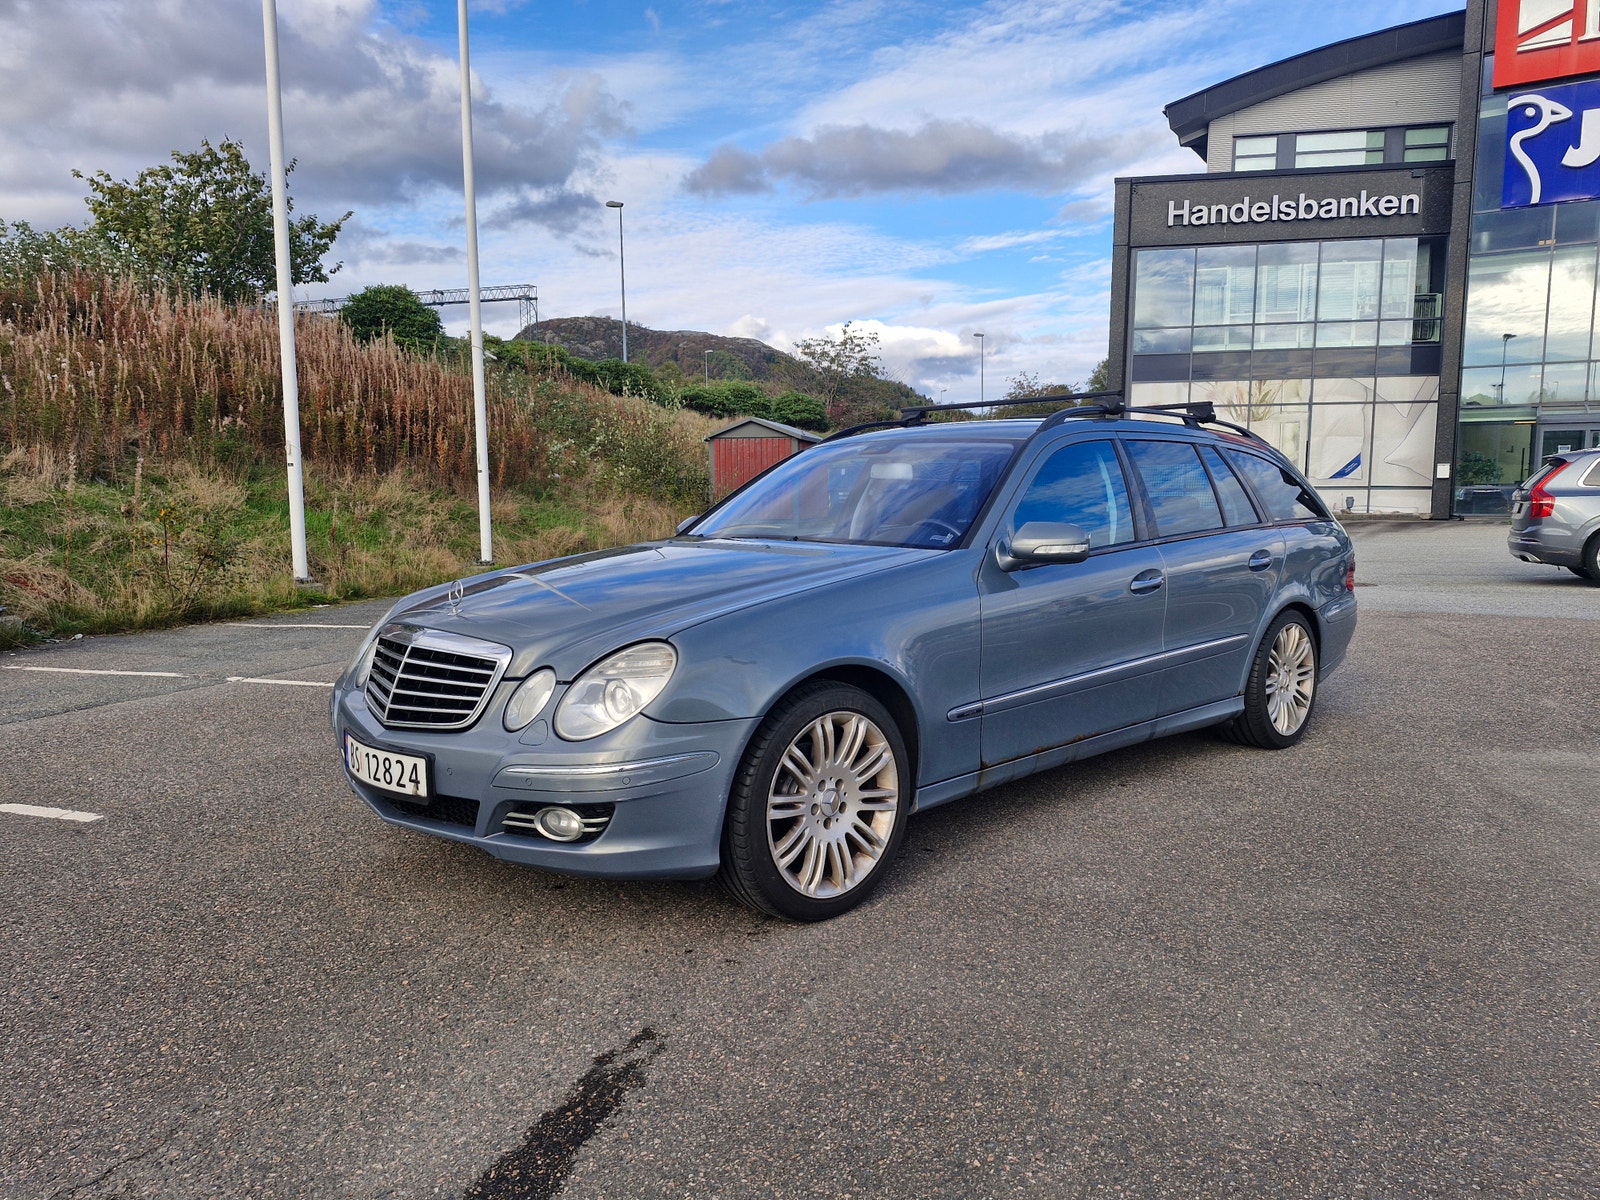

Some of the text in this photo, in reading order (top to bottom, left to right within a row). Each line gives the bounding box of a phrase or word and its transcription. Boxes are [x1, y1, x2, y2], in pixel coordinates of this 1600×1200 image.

[1167, 190, 1420, 226] Handelsbanken
[350, 742, 420, 791] BS 12824
